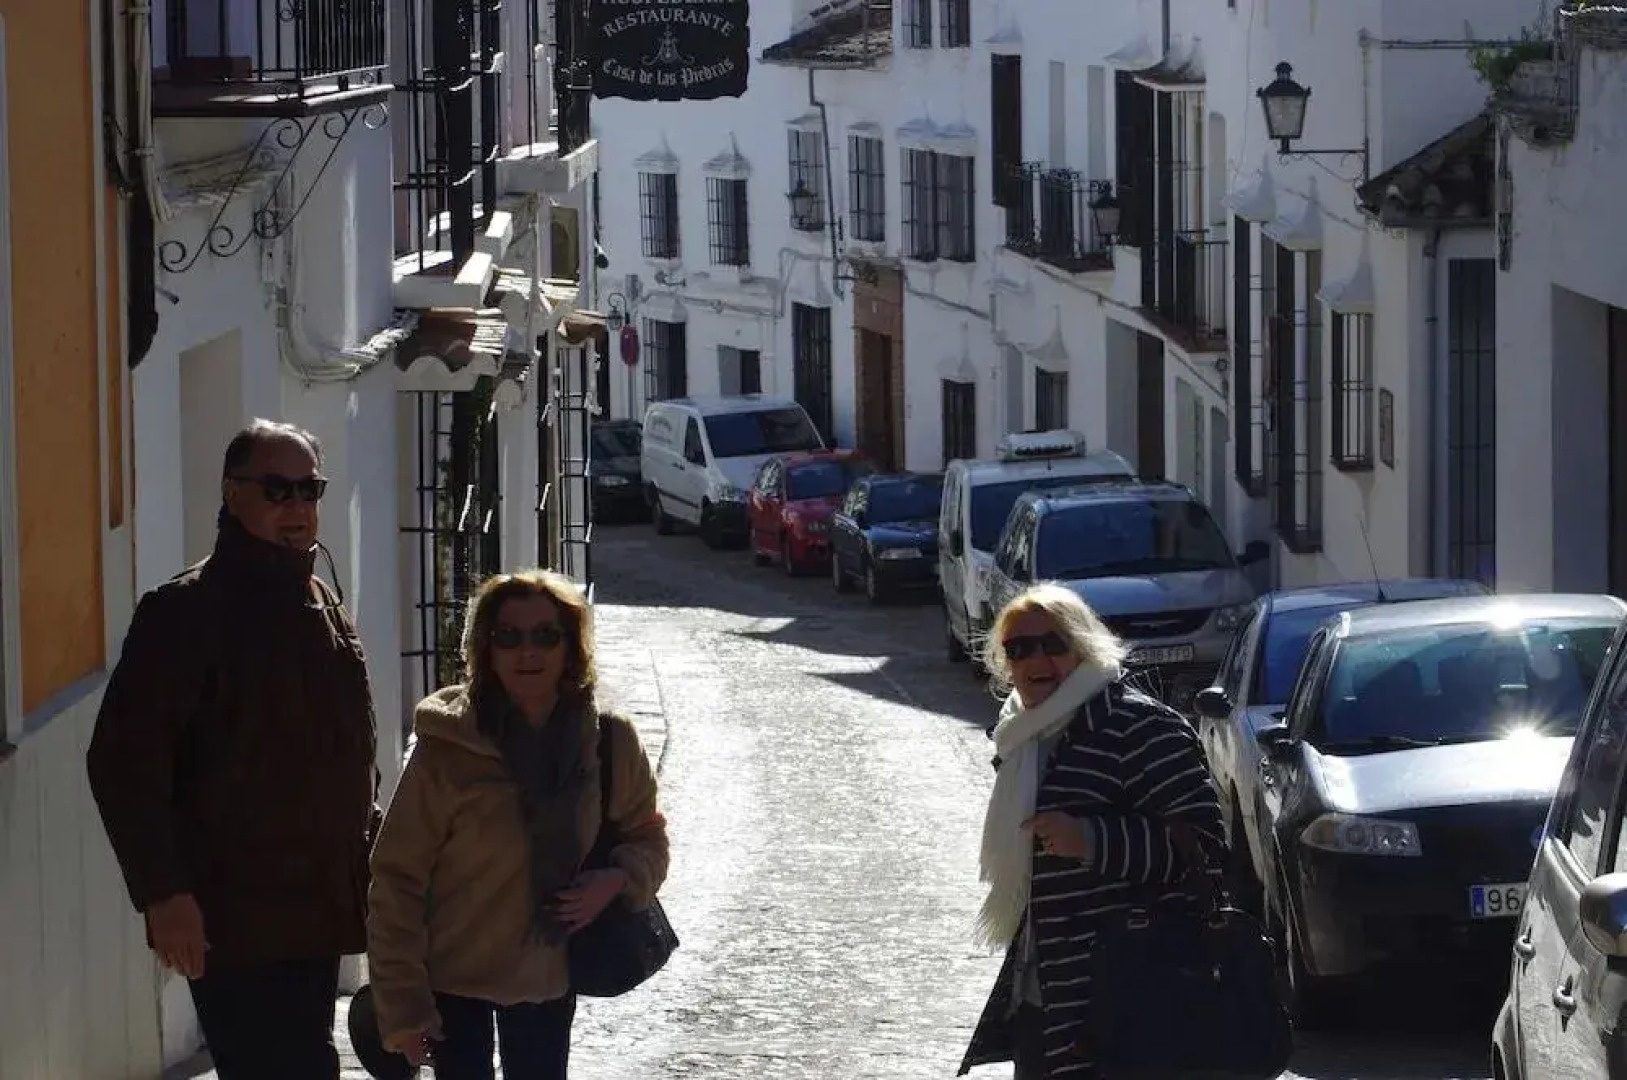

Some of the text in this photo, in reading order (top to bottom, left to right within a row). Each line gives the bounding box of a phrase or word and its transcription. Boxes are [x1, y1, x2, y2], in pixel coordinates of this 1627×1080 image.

[602, 8, 734, 37] RESTAURANTE
[602, 57, 735, 88] Casa de las Piedras
